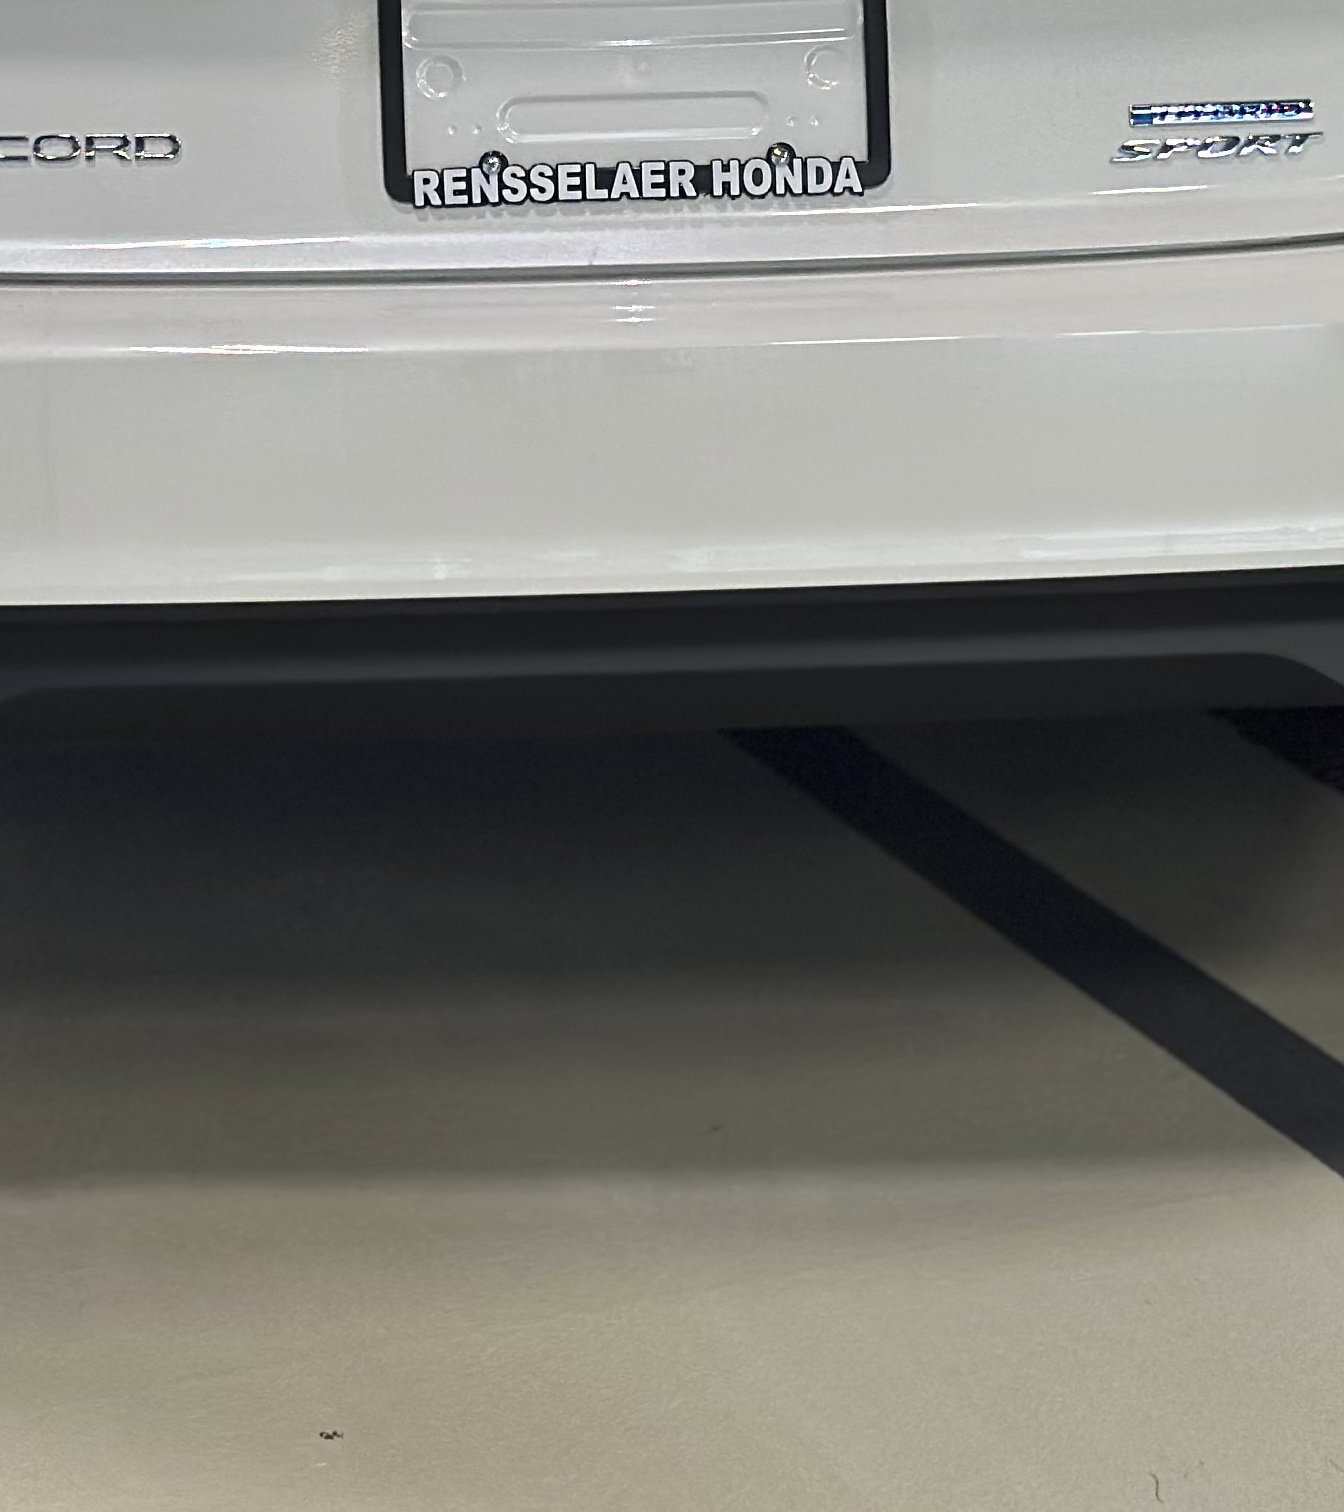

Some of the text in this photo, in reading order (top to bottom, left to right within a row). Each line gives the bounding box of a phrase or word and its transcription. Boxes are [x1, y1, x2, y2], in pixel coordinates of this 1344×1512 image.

[1110, 131, 1324, 164] SPORT
[413, 156, 863, 207] RENSSELAER HONDA
